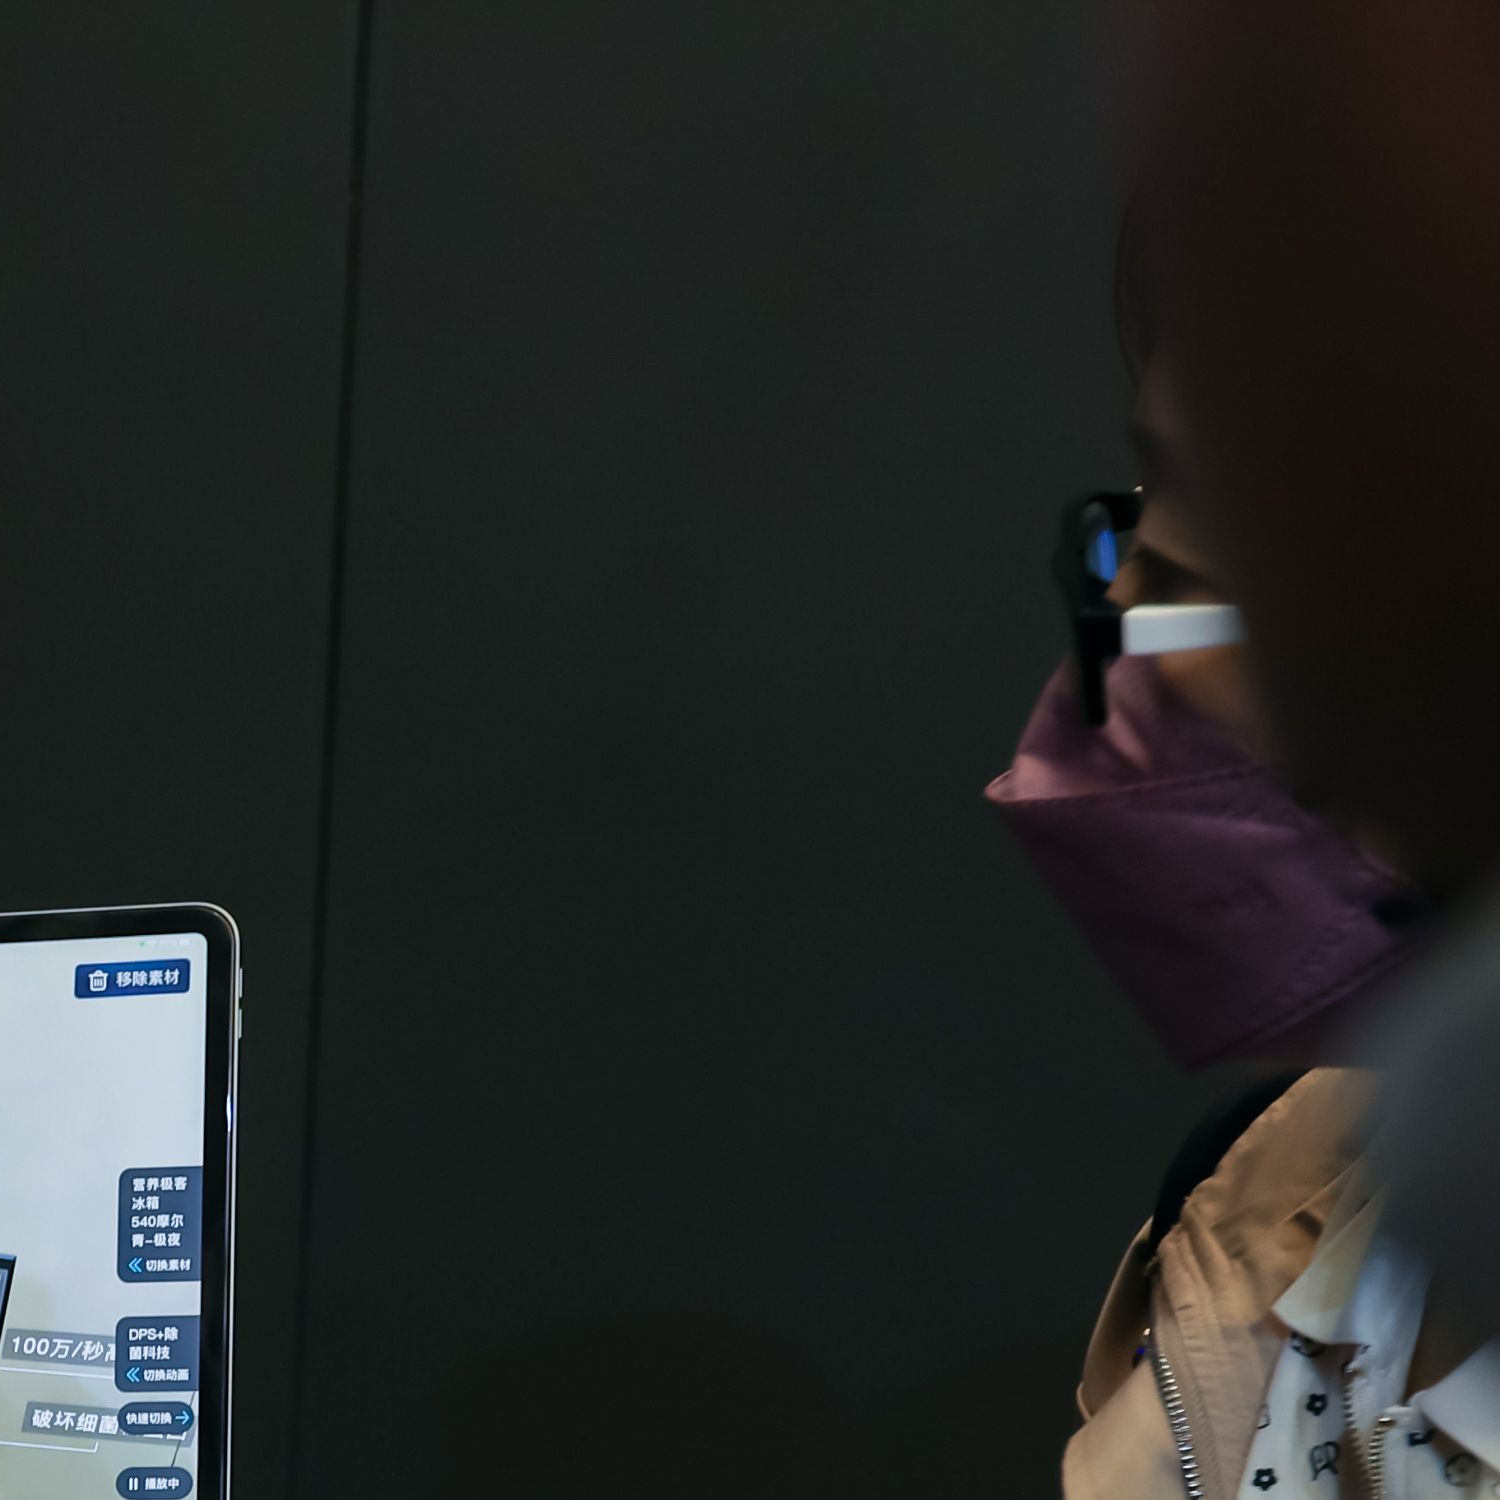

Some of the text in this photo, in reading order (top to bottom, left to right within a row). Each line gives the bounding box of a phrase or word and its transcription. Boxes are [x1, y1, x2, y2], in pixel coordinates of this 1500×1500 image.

[116, 968, 180, 988] 移除素材
[132, 1176, 188, 1192] 营养极客
[131, 1196, 160, 1211] 冰箱
[131, 1214, 184, 1229] 540摩尔
[145, 1258, 191, 1272] 切换素材
[128, 1326, 179, 1341] DPS+除
[128, 1345, 171, 1361] 菌科技
[143, 1368, 190, 1382] 切换动画
[144, 1477, 180, 1490] 播放中
